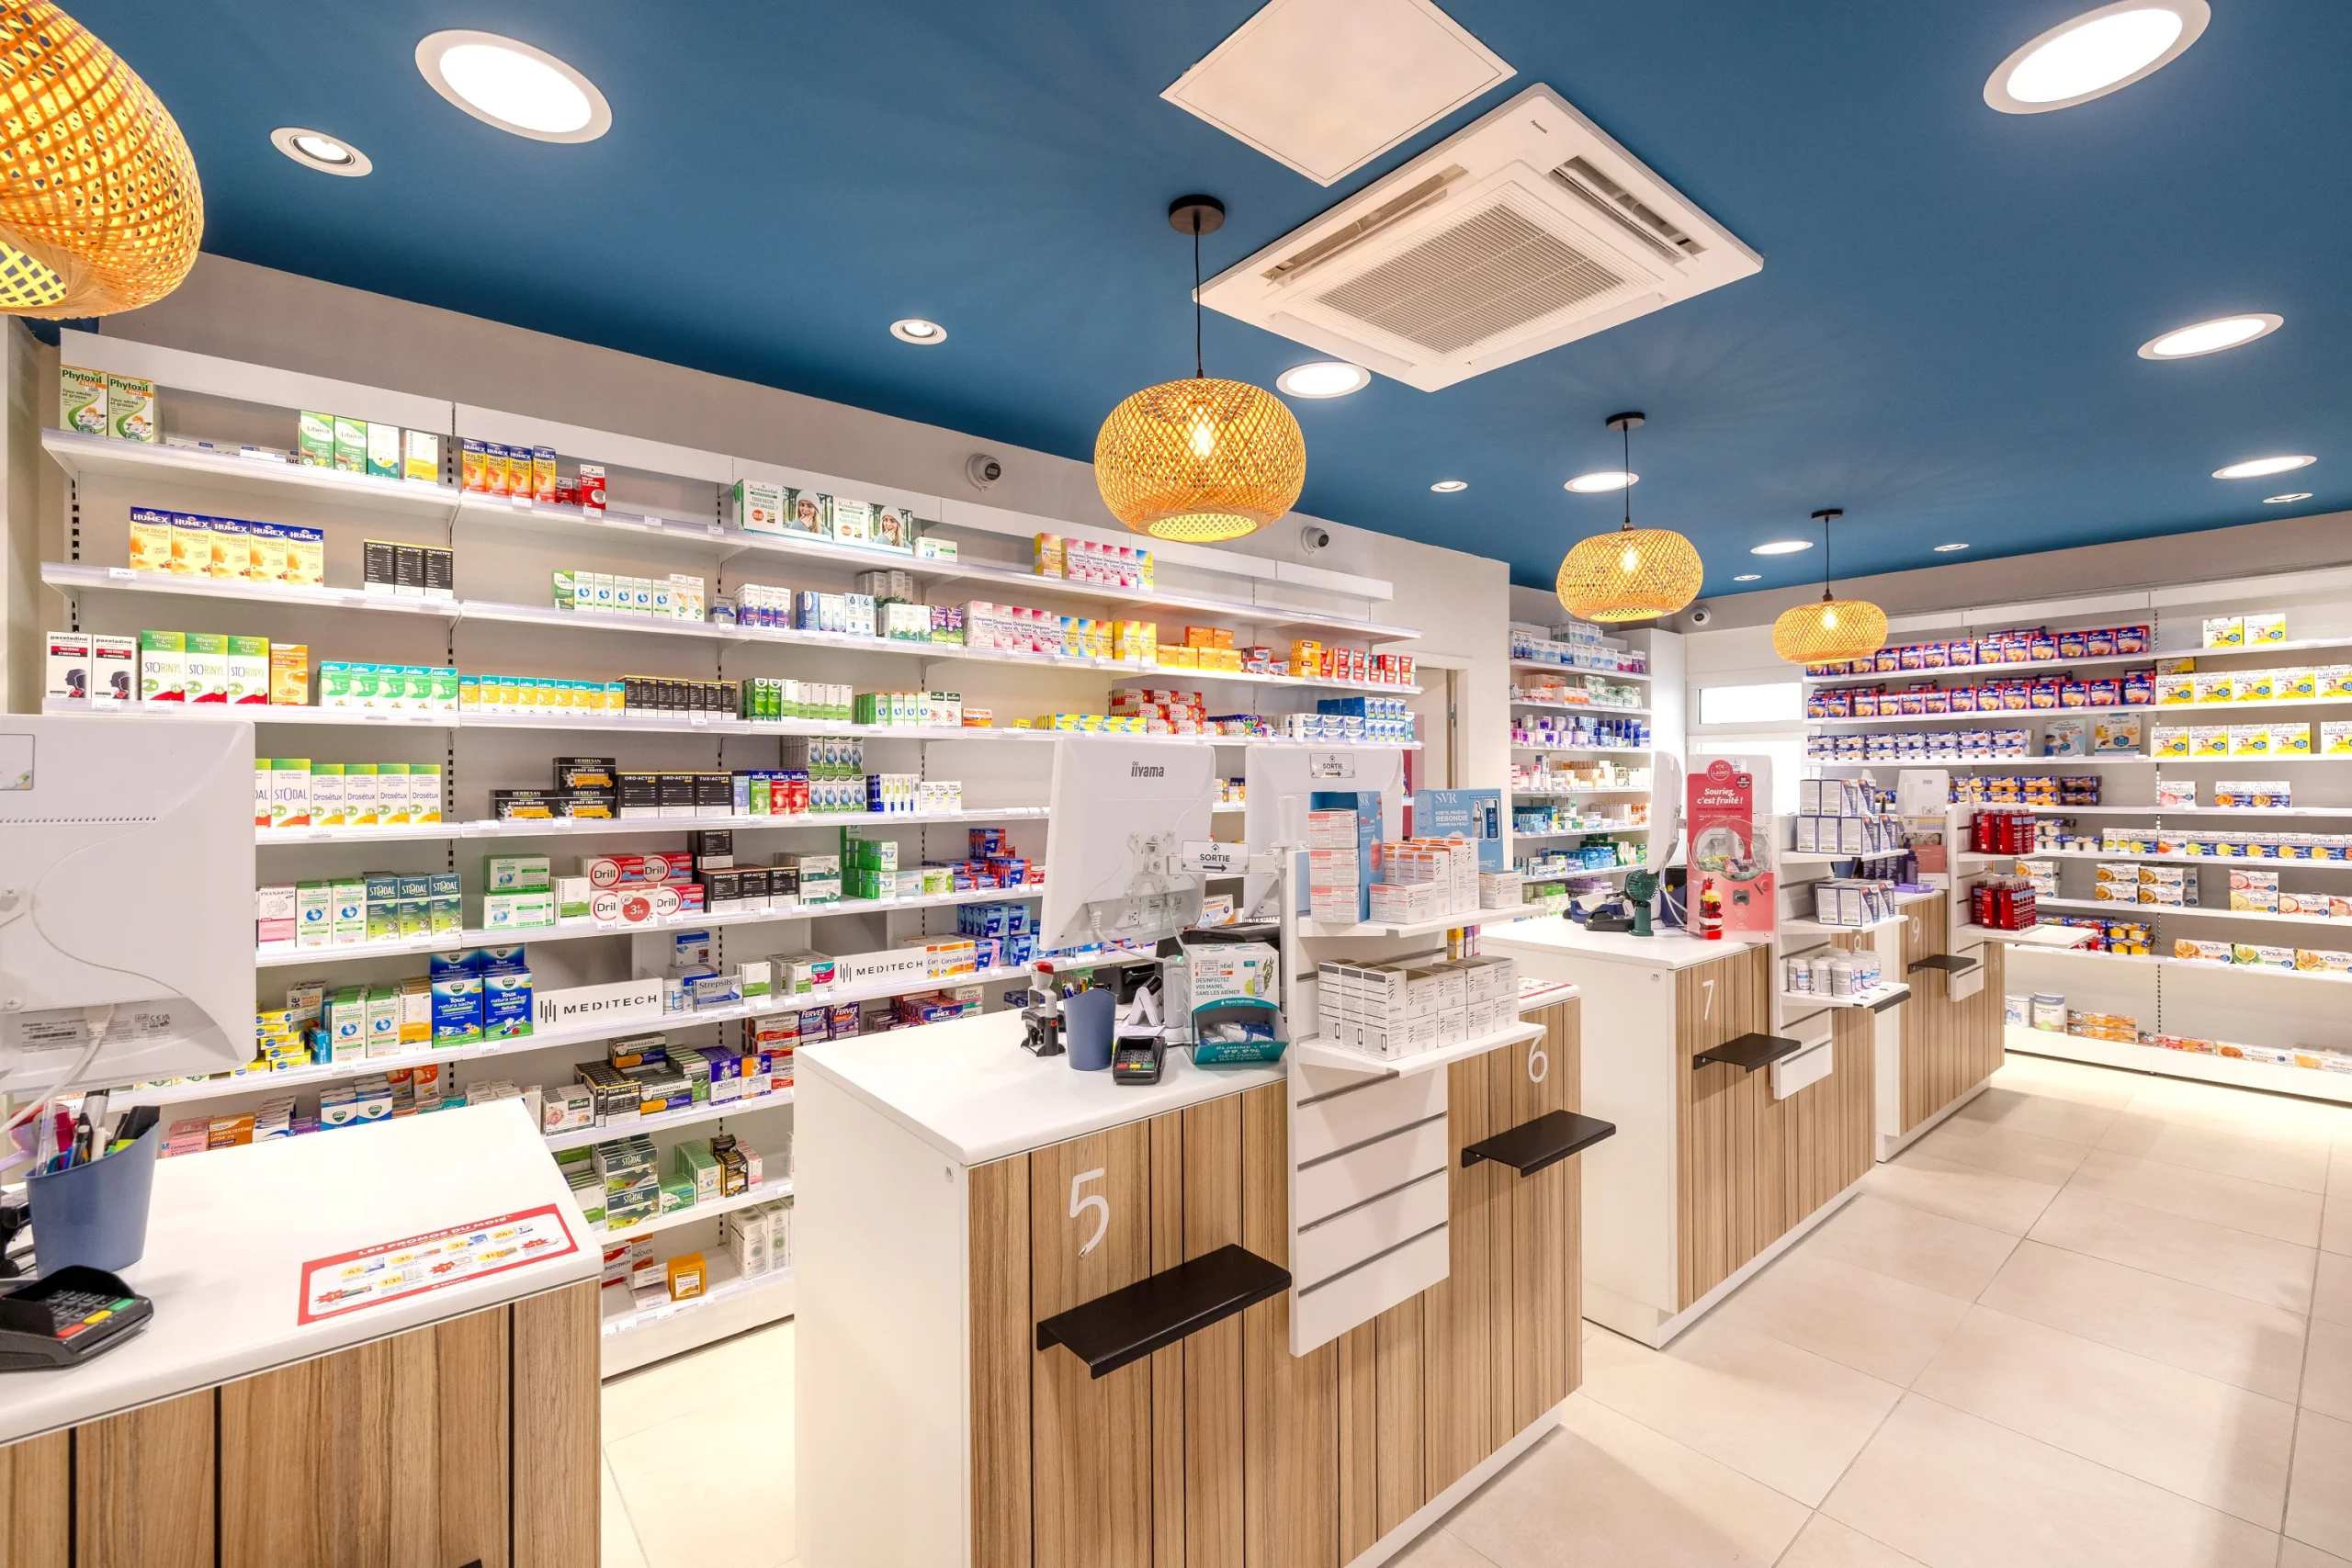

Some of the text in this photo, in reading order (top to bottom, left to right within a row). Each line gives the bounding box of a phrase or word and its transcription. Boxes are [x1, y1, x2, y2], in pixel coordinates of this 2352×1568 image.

[62, 369, 102, 384] Phytoxil
[109, 378, 149, 392] Phytoxil
[463, 445, 485, 453] HUMEX
[487, 448, 508, 457] HUMEX
[510, 451, 531, 459] HUMEX
[535, 451, 555, 459] HUMEX
[749, 484, 778, 494] Puressentiel
[838, 502, 865, 510] Puressentiel
[133, 513, 168, 524] HUMEX
[175, 519, 209, 529] HUMEX
[214, 524, 247, 533] HUMEX
[253, 527, 285, 537] HUMEX
[289, 531, 321, 541] HUMEX
[51, 635, 88, 643] paxeladine
[96, 637, 132, 646] paxeladine
[152, 634, 176, 645] Rhume
[196, 637, 220, 646] Rhume
[237, 639, 260, 649] Rhume
[144, 661, 183, 674] STORINYL
[188, 664, 224, 676] STORINYL
[231, 666, 266, 678] STORINYL
[1131, 761, 1165, 778] iiyama
[275, 787, 308, 801] STODAL
[313, 793, 343, 801] Drosétux
[347, 792, 376, 800] Drosétux
[380, 791, 407, 799] Drosétux
[413, 791, 439, 799] Drosétux
[1704, 788, 1735, 797] Souriez,
[1359, 794, 1370, 807] SVR
[1435, 793, 1457, 804] SVR
[1716, 796, 1739, 806] fruité
[1199, 853, 1230, 863] SORTIE
[594, 869, 616, 878] Drill
[645, 866, 665, 874] Drill
[369, 885, 396, 897] STODAL
[401, 883, 427, 895] STODAL
[433, 880, 458, 892] STODAL
[657, 898, 677, 908] Drill
[1913, 916, 1920, 943] 9
[2200, 944, 2230, 953] Clinutren
[2261, 950, 2292, 958] Clinutren
[941, 956, 963, 964] Coryzalia
[856, 960, 923, 976] MEDITECH
[699, 979, 732, 989] Strepsils
[563, 994, 658, 1015] MEDITECH
[1702, 979, 1714, 1021] 7
[801, 1007, 826, 1019] FERVEX
[836, 1007, 858, 1016] FERVEX
[1528, 1036, 1547, 1083] 6
[210, 1126, 253, 1137] CARBOCISTÉINE
[622, 1155, 642, 1167] STODAL
[623, 1191, 643, 1204] STODAL
[1069, 1167, 1110, 1258] 5
[358, 1217, 506, 1256] LES PROMOS DU MOIS
